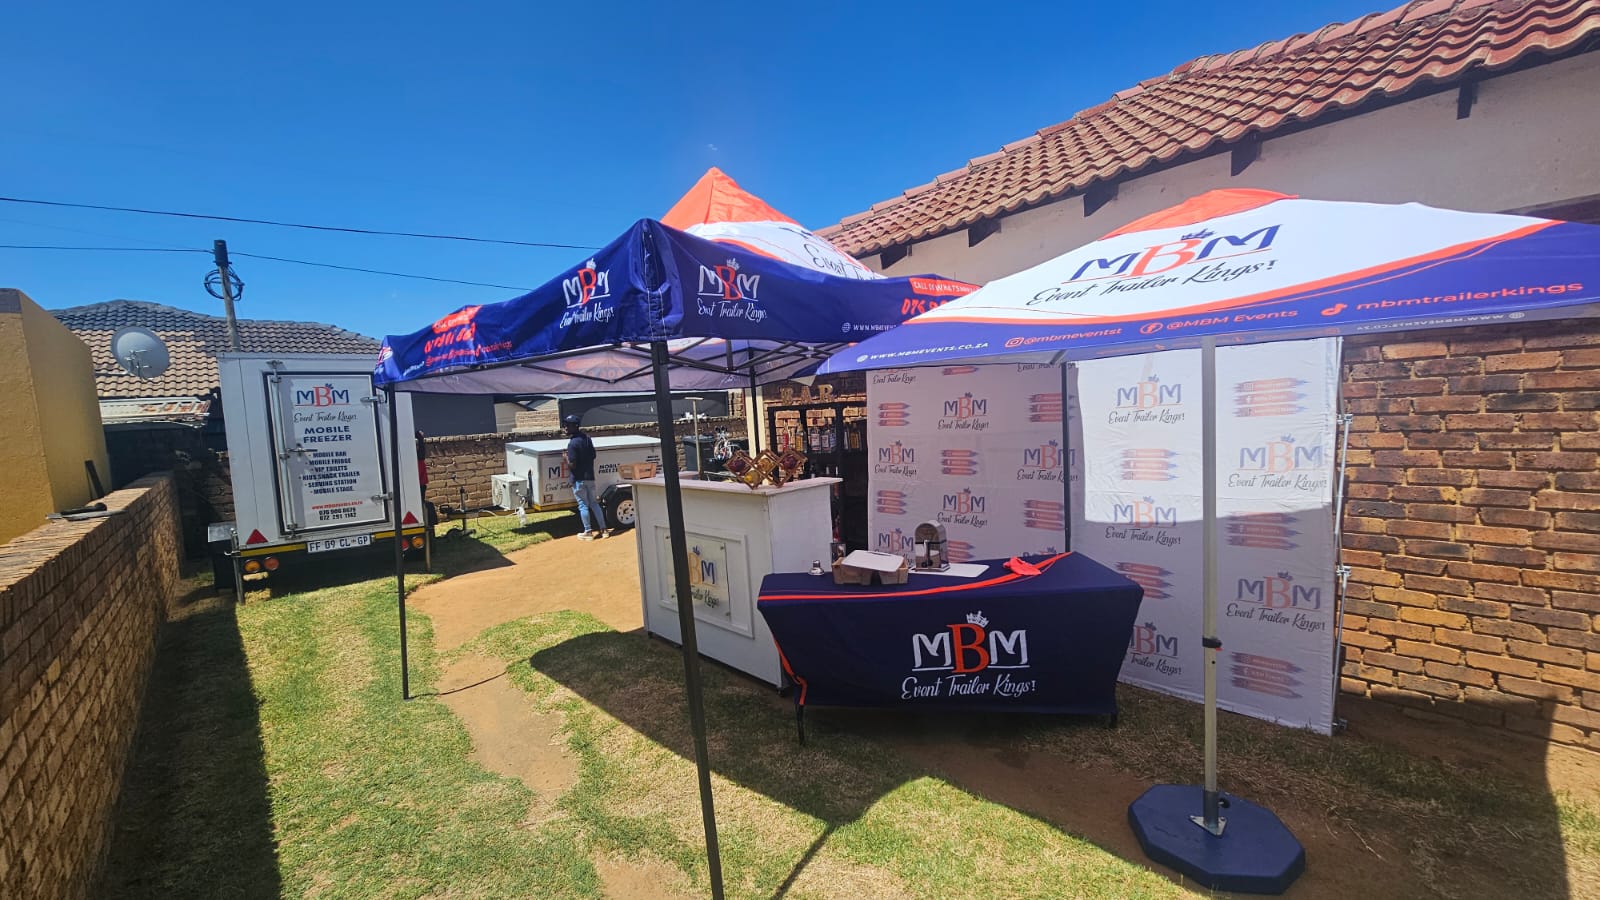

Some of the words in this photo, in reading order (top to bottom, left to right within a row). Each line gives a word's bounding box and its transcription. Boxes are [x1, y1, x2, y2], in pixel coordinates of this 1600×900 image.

[1071, 225, 1281, 281] MBM
[699, 265, 760, 299] MBM
[1026, 288, 1099, 306] Event
[1100, 276, 1179, 296] Trailer
[1182, 260, 1278, 285] Kings!
[1356, 282, 1585, 311] mbmtrailerkings
[718, 301, 743, 318] Trailer
[1166, 316, 1229, 331] @MBM
[1234, 309, 1299, 323] Events
[870, 342, 988, 360] WWW.MBMEVENTS.CO.ZA
[297, 386, 349, 407] MBM
[1117, 382, 1181, 409] MBM
[943, 397, 987, 419] MBM
[1108, 411, 1130, 424] Event
[1132, 410, 1157, 422] Trailer
[1159, 409, 1185, 424] Kings!
[304, 426, 350, 434] MOBILE
[304, 434, 352, 443] FREEZER
[878, 444, 914, 464] MBM
[1240, 442, 1322, 473] MBM
[1229, 473, 1258, 488] Event
[1259, 473, 1291, 488] Trailer
[943, 491, 985, 514] MBM
[1114, 501, 1176, 528] MBM
[309, 542, 320, 551] FF
[324, 540, 336, 549] 09
[340, 538, 351, 547] CL
[357, 536, 368, 545] GP
[878, 530, 914, 551] MBM
[1105, 526, 1128, 539] Event
[1129, 529, 1153, 541] Trailer
[688, 552, 715, 585] BM
[1237, 576, 1320, 610] MBM
[1226, 602, 1254, 619] Event
[1258, 607, 1289, 625] Trailer
[1292, 613, 1325, 632] Kings!
[912, 623, 1029, 673] MBM
[901, 676, 943, 700] Event
[945, 674, 990, 696] Trailer
[993, 674, 1037, 697] Kings!
